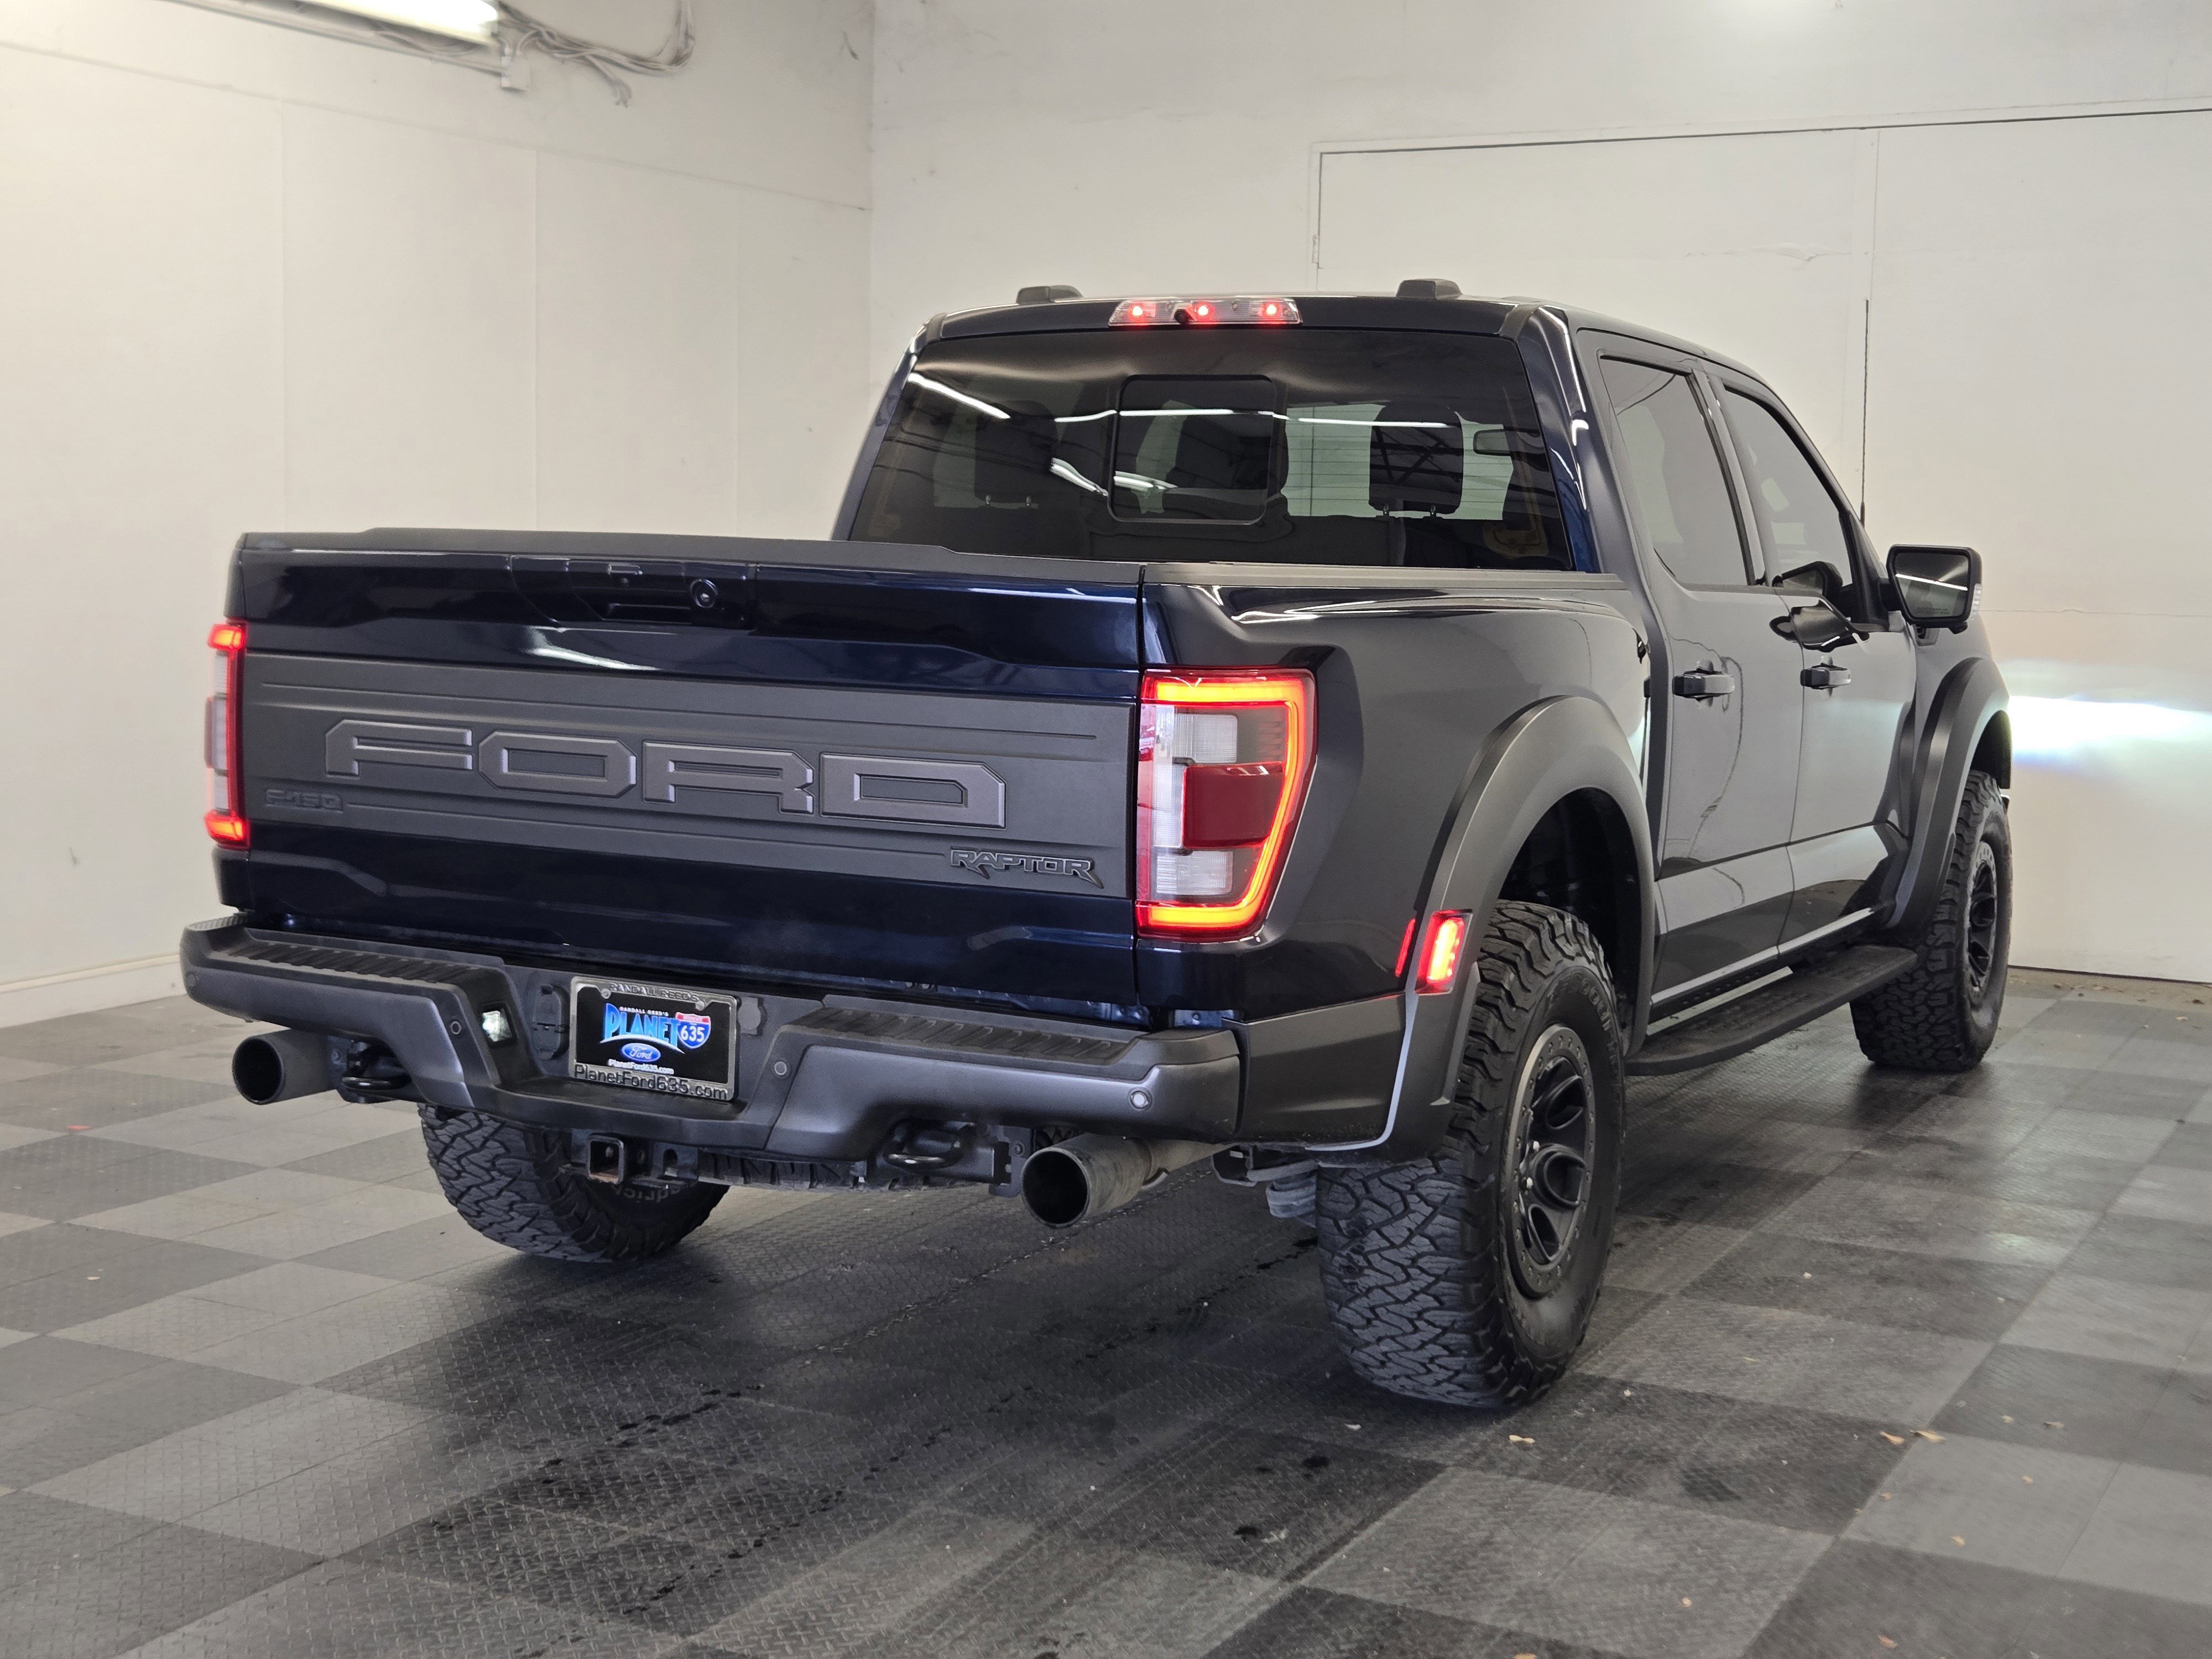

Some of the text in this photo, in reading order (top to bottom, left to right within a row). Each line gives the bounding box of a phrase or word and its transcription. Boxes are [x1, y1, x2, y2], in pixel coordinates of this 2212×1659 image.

[325, 718, 1006, 830] FORD
[951, 848, 1104, 889] RAPTOR
[609, 982, 658, 996] RANDALL
[604, 1003, 680, 1048] PLANET
[681, 1025, 705, 1042] 635
[629, 1045, 653, 1060] Ford
[574, 1063, 728, 1100] PlanetFord635.com
